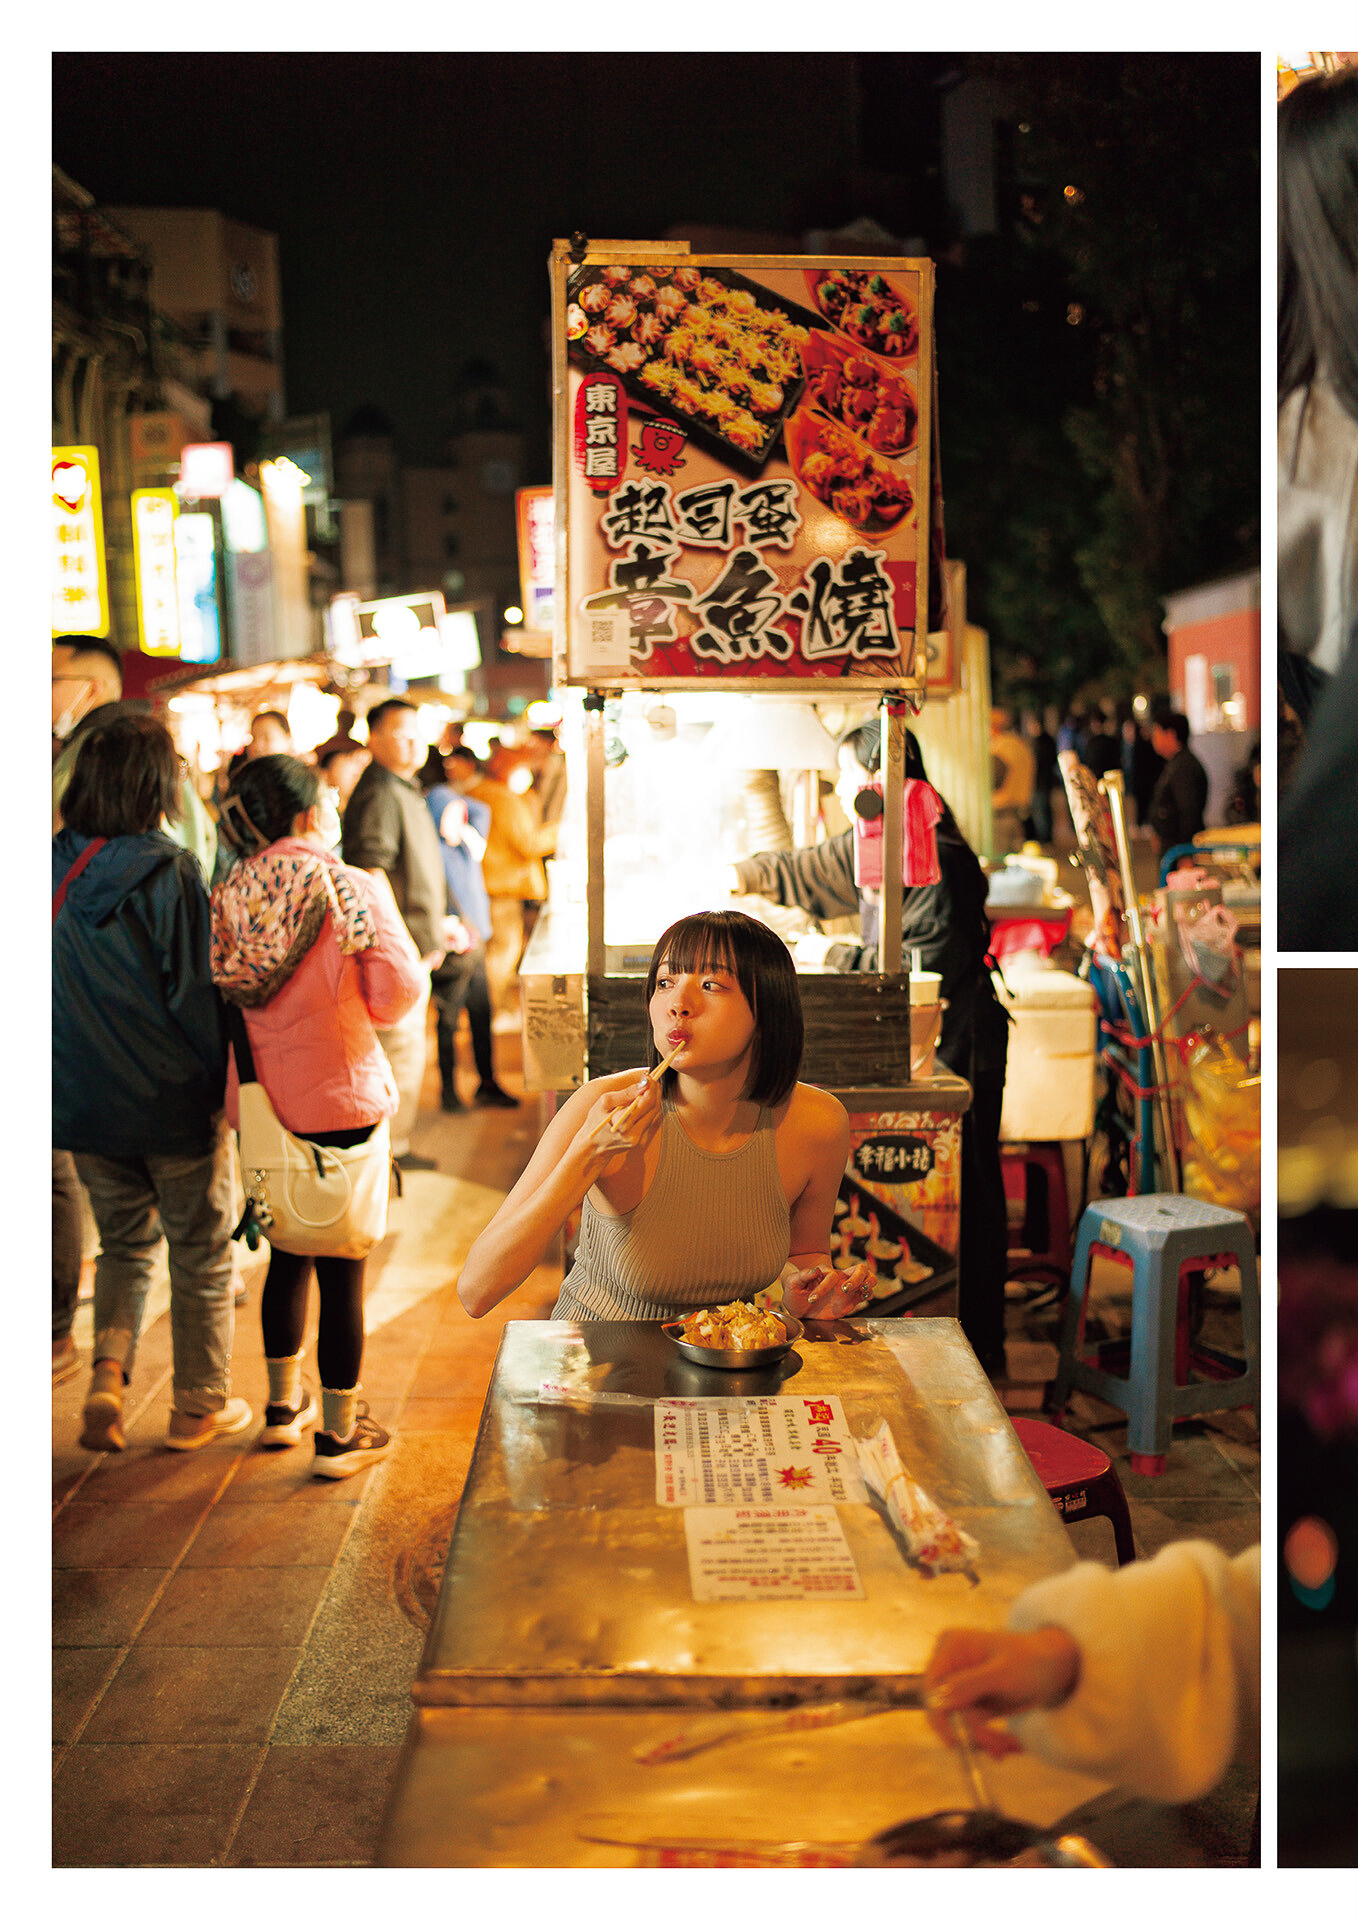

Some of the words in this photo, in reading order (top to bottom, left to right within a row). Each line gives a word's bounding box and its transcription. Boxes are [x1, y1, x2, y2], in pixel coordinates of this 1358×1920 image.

[584, 382, 619, 477] 東京屋
[602, 480, 801, 546] 起司蛋
[582, 542, 900, 660] 章魚燒
[856, 1144, 930, 1173] 幸福小站
